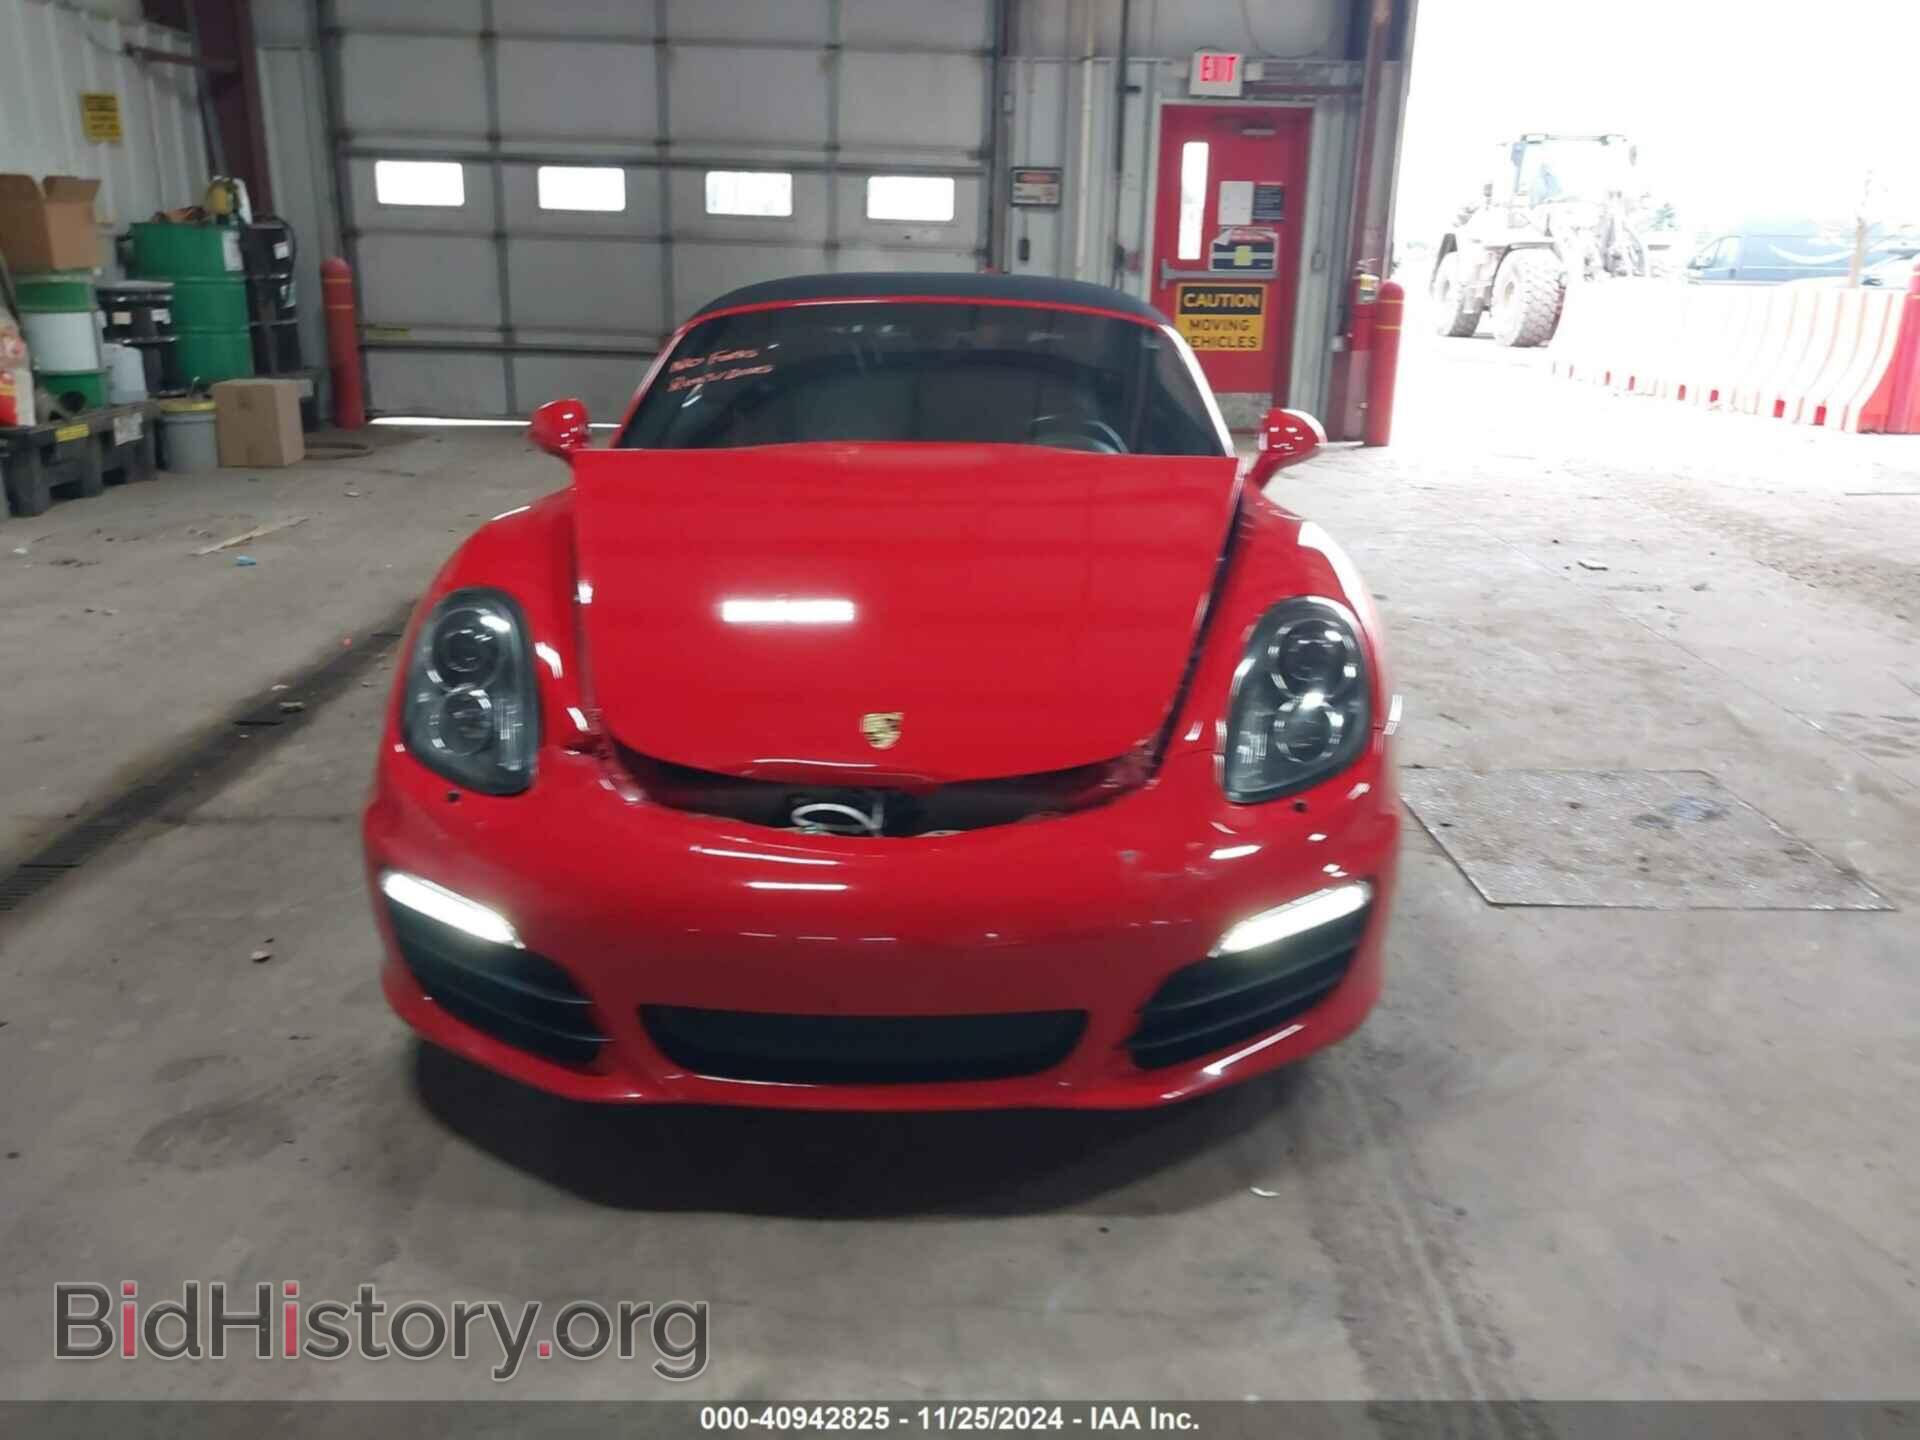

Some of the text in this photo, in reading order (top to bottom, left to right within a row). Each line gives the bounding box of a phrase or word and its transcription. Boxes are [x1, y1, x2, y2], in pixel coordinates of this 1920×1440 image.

[1201, 54, 1237, 82] EXIT
[1183, 292, 1260, 309] CAUTION
[1188, 318, 1250, 332] MOVING
